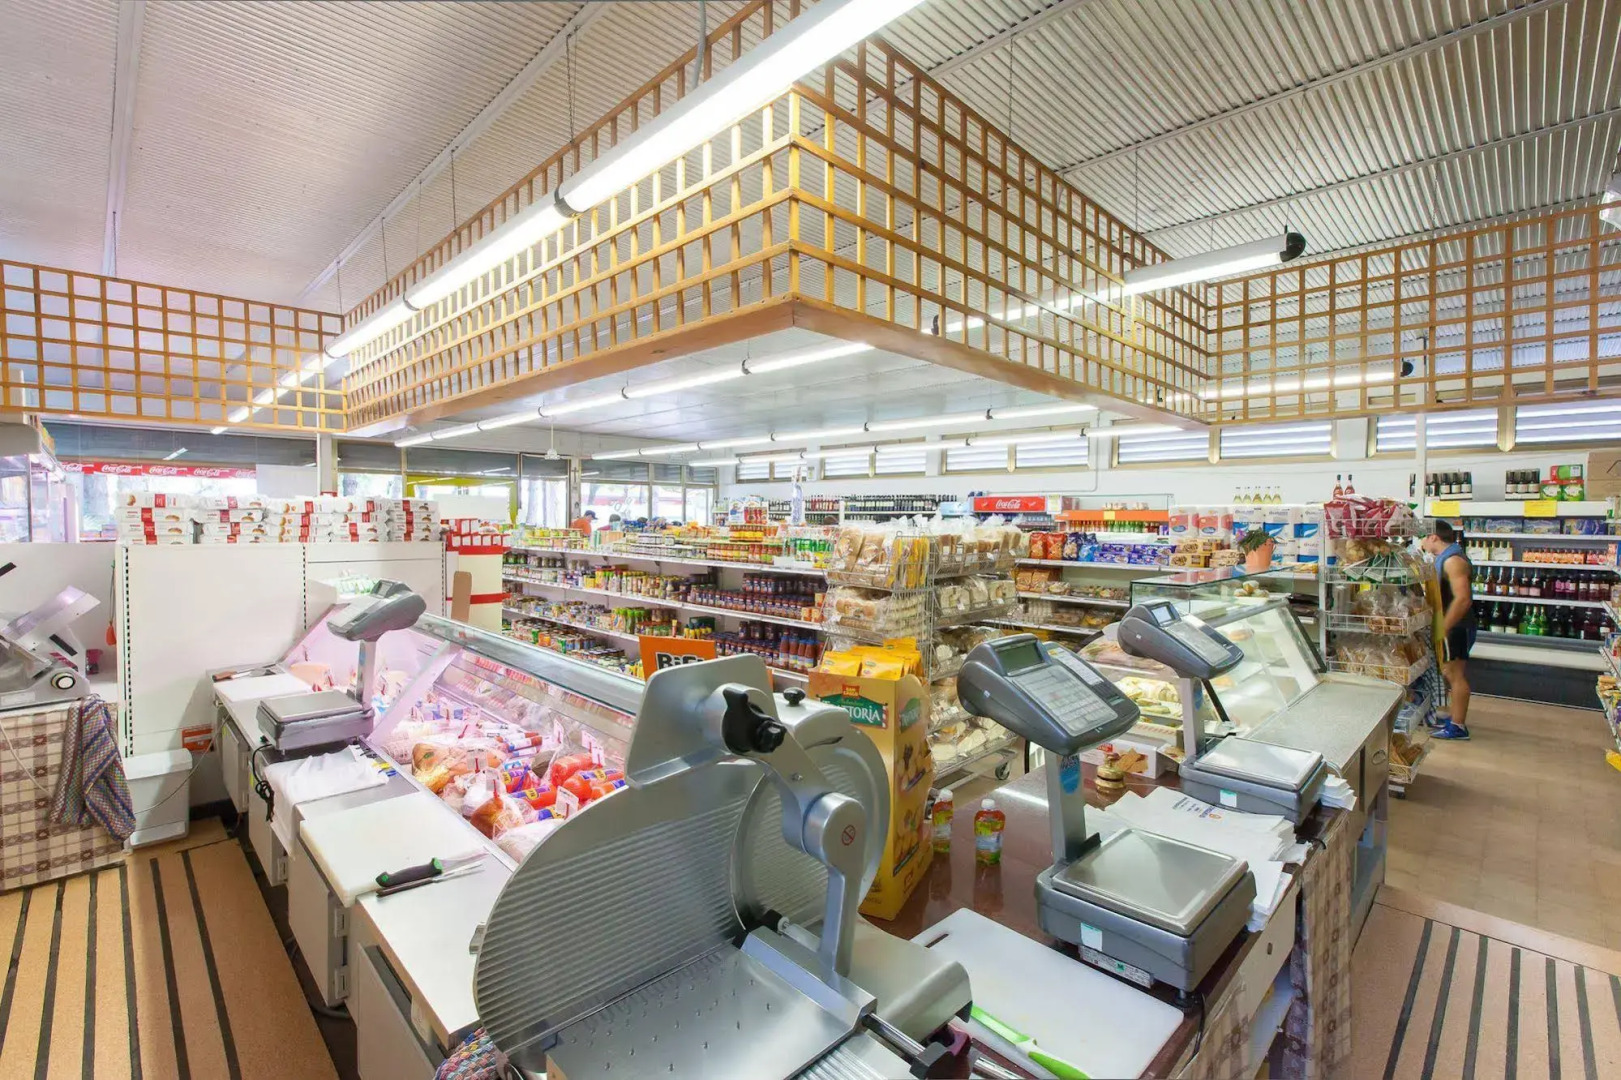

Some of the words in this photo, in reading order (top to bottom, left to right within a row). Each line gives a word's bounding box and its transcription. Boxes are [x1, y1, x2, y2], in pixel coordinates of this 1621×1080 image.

[101, 464, 132, 474] Coca-Cola
[149, 465, 177, 475] Coca-Cola
[193, 467, 220, 477] Coca-Cola
[995, 499, 1021, 509] Coca-Cola
